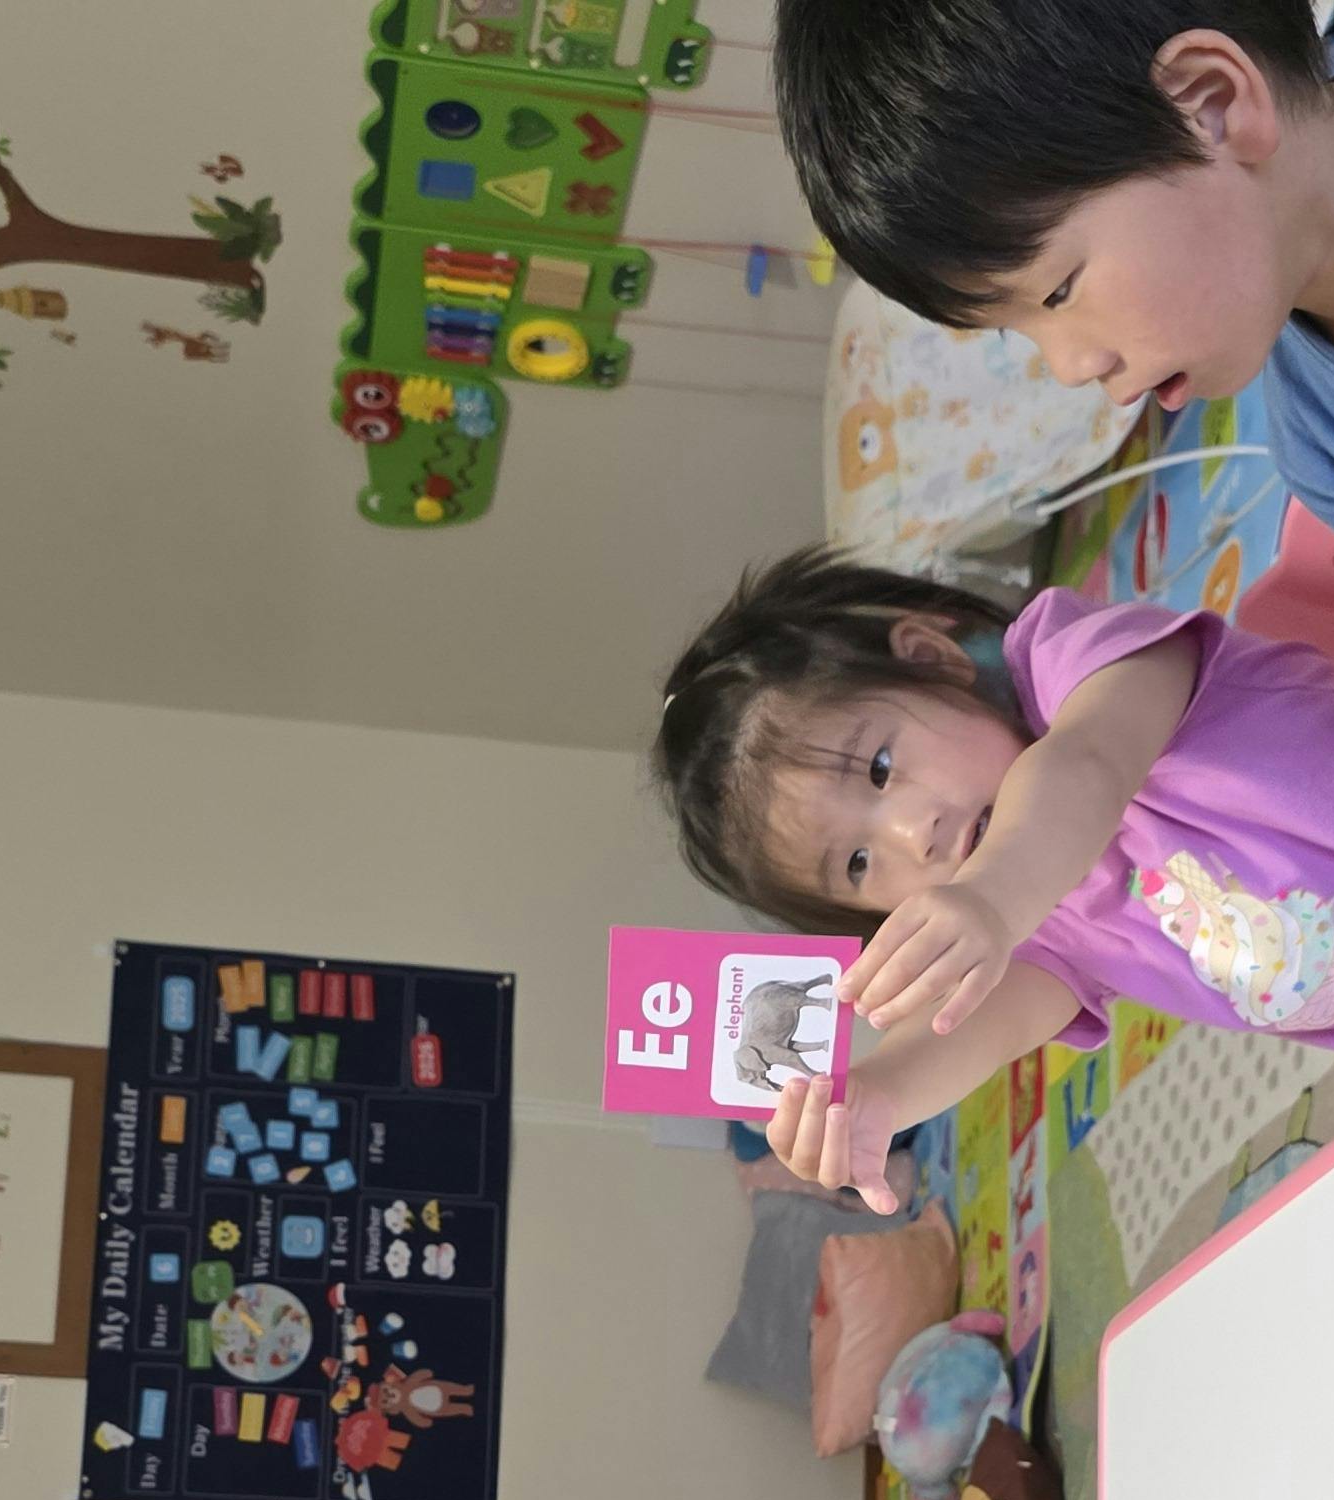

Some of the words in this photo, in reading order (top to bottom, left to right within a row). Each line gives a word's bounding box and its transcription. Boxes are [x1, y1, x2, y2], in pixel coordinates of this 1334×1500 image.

[617, 980, 693, 1070] Ee
[723, 965, 746, 1039] elephant
[166, 1033, 184, 1073] Year
[107, 1081, 139, 1214] Calendar
[369, 1121, 385, 1153] Feel
[159, 1151, 178, 1207] Month
[252, 1194, 274, 1276] Weather
[331, 1214, 350, 1252] feel
[365, 1206, 382, 1272] Weather
[102, 1223, 135, 1297] Daily
[98, 1305, 129, 1349] My
[150, 1303, 168, 1346] Date
[190, 1422, 211, 1456] Day
[140, 1452, 161, 1488] Day
